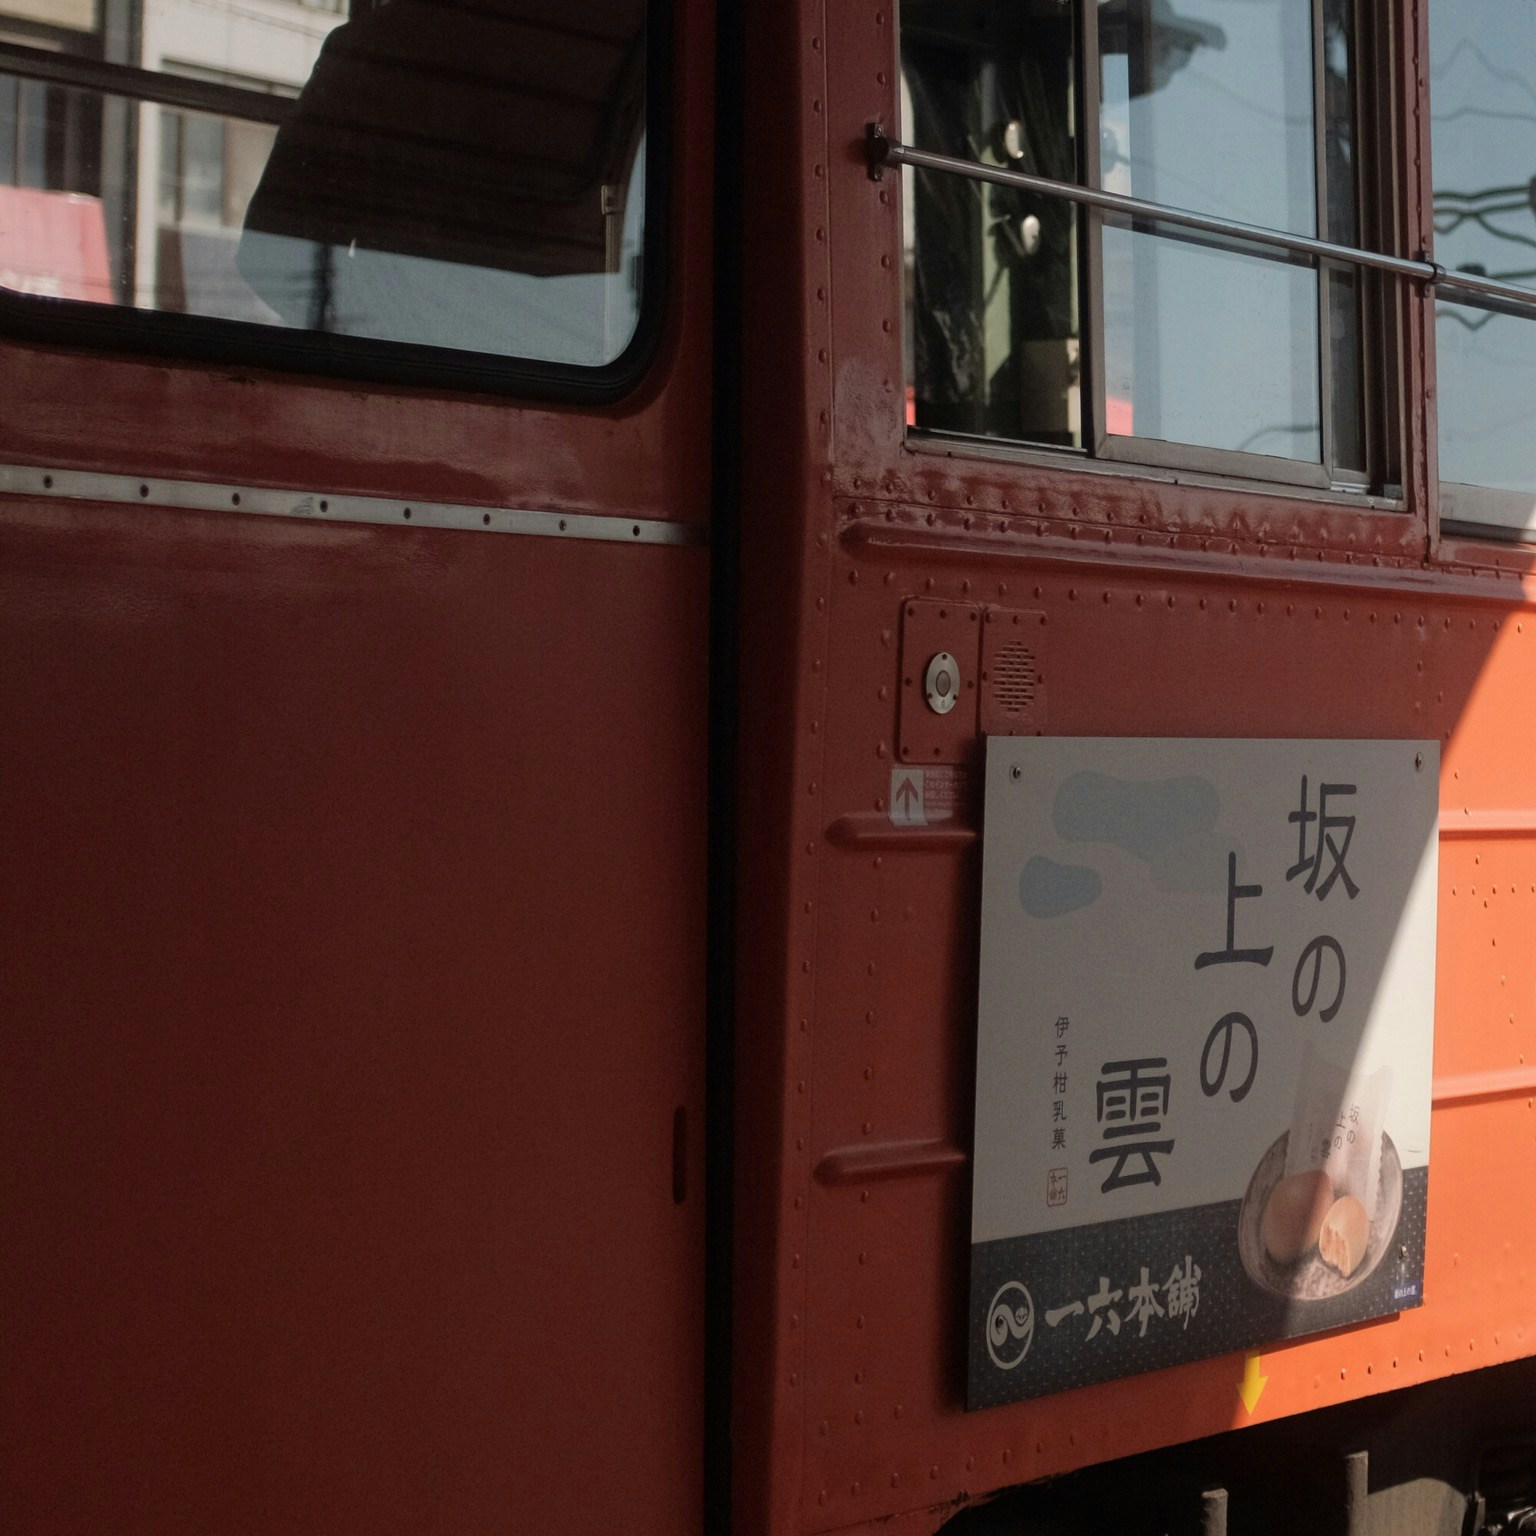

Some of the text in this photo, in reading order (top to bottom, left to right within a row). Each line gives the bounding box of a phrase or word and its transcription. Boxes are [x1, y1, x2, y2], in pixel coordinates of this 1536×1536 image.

[1194, 851, 1275, 1104] 上の
[1287, 774, 1361, 1024] 坂の
[1051, 1016, 1070, 1150] 伊予柑乳菓
[1088, 1057, 1176, 1195] 雲
